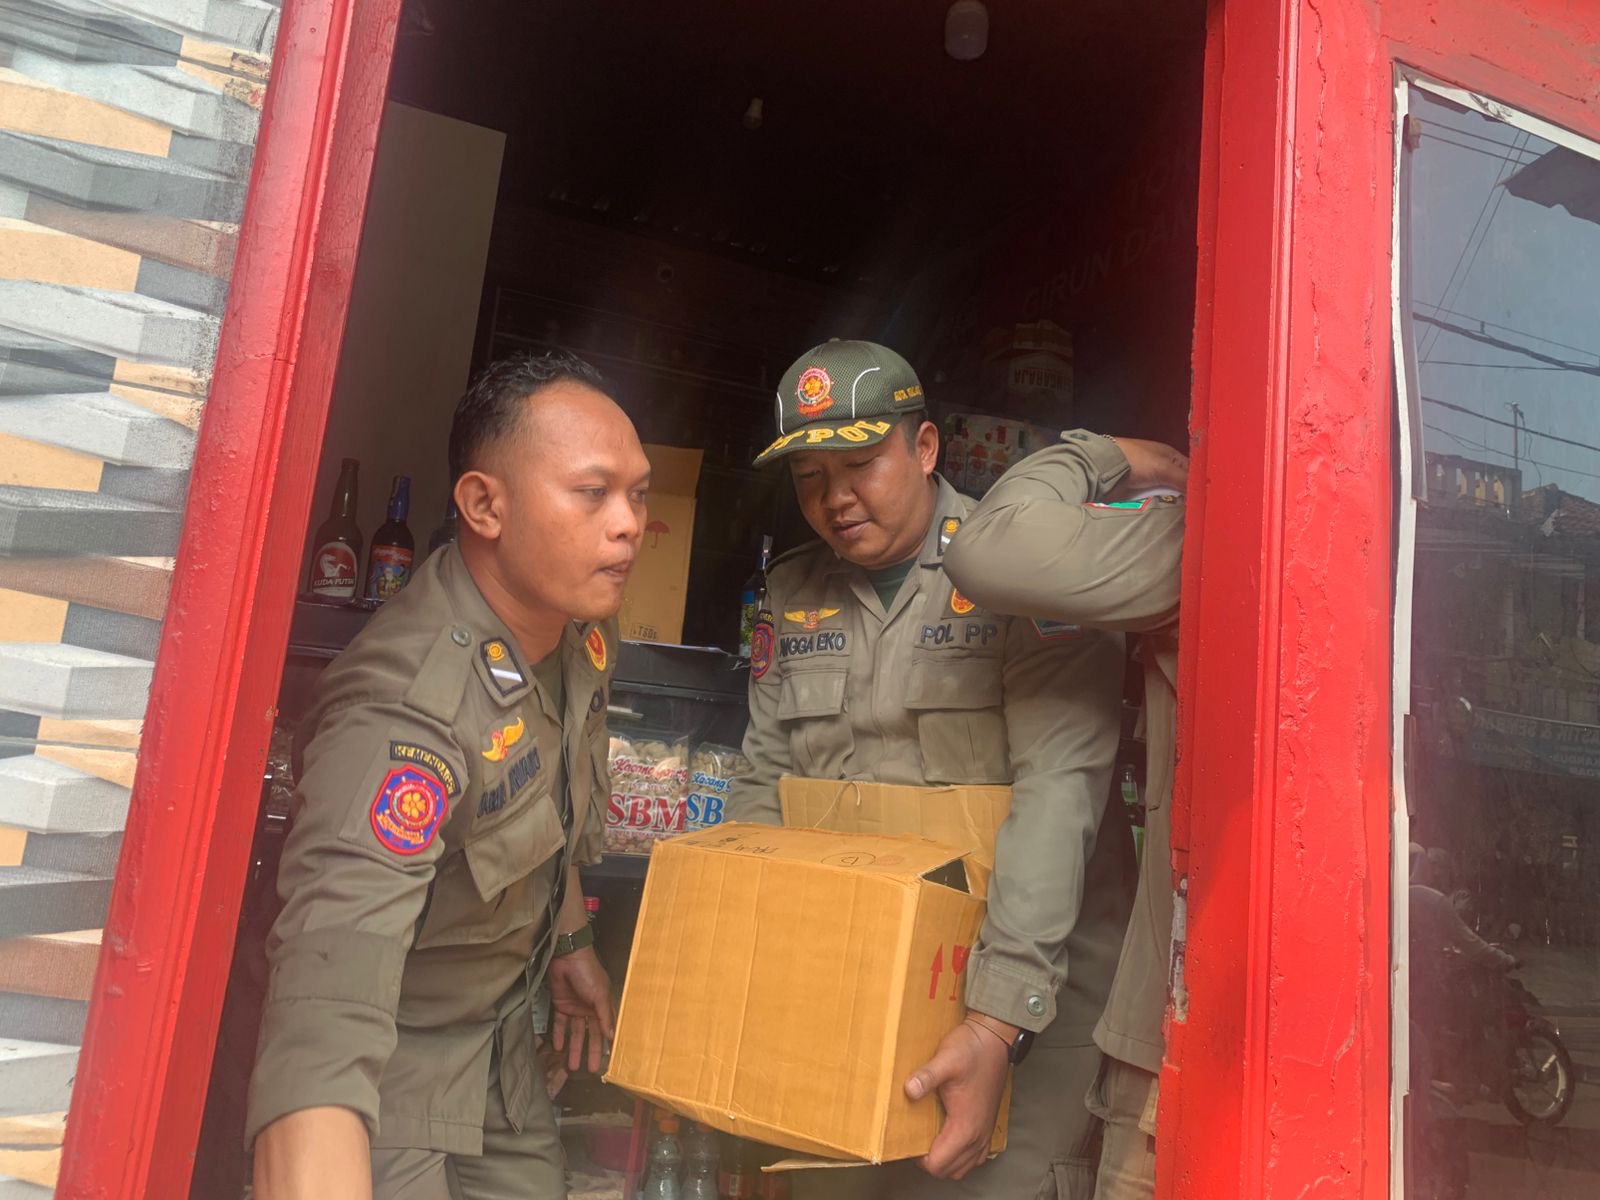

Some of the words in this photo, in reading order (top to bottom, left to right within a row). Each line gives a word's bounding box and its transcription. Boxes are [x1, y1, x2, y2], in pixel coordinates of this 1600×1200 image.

[817, 632, 846, 651] EKO
[921, 623, 954, 645] POL
[965, 623, 998, 645] PP
[692, 771, 726, 793] Kacang
[606, 792, 688, 832] SBM
[686, 792, 725, 825] SB
